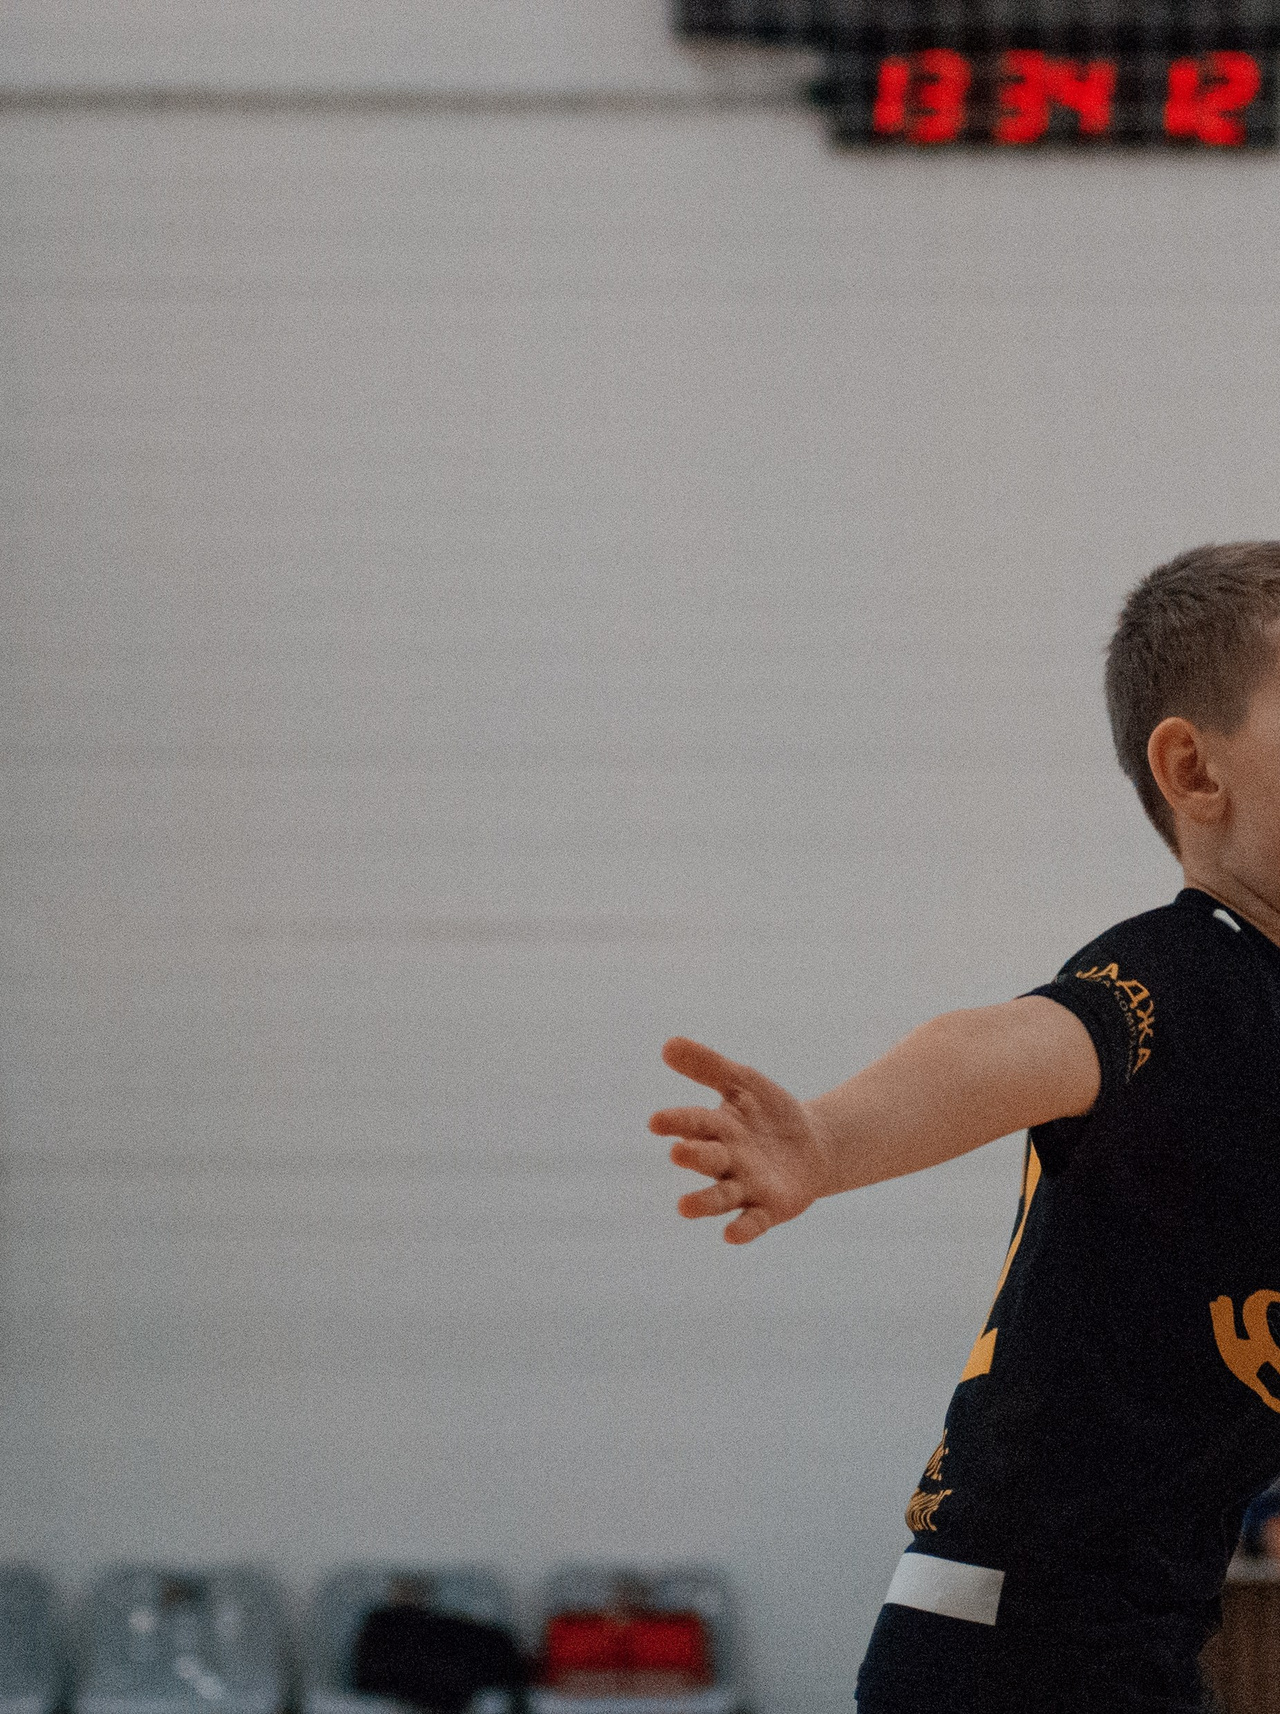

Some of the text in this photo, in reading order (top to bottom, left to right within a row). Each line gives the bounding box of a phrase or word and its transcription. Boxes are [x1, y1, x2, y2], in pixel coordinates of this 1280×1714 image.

[873, 48, 1261, 146] 13 34 12
